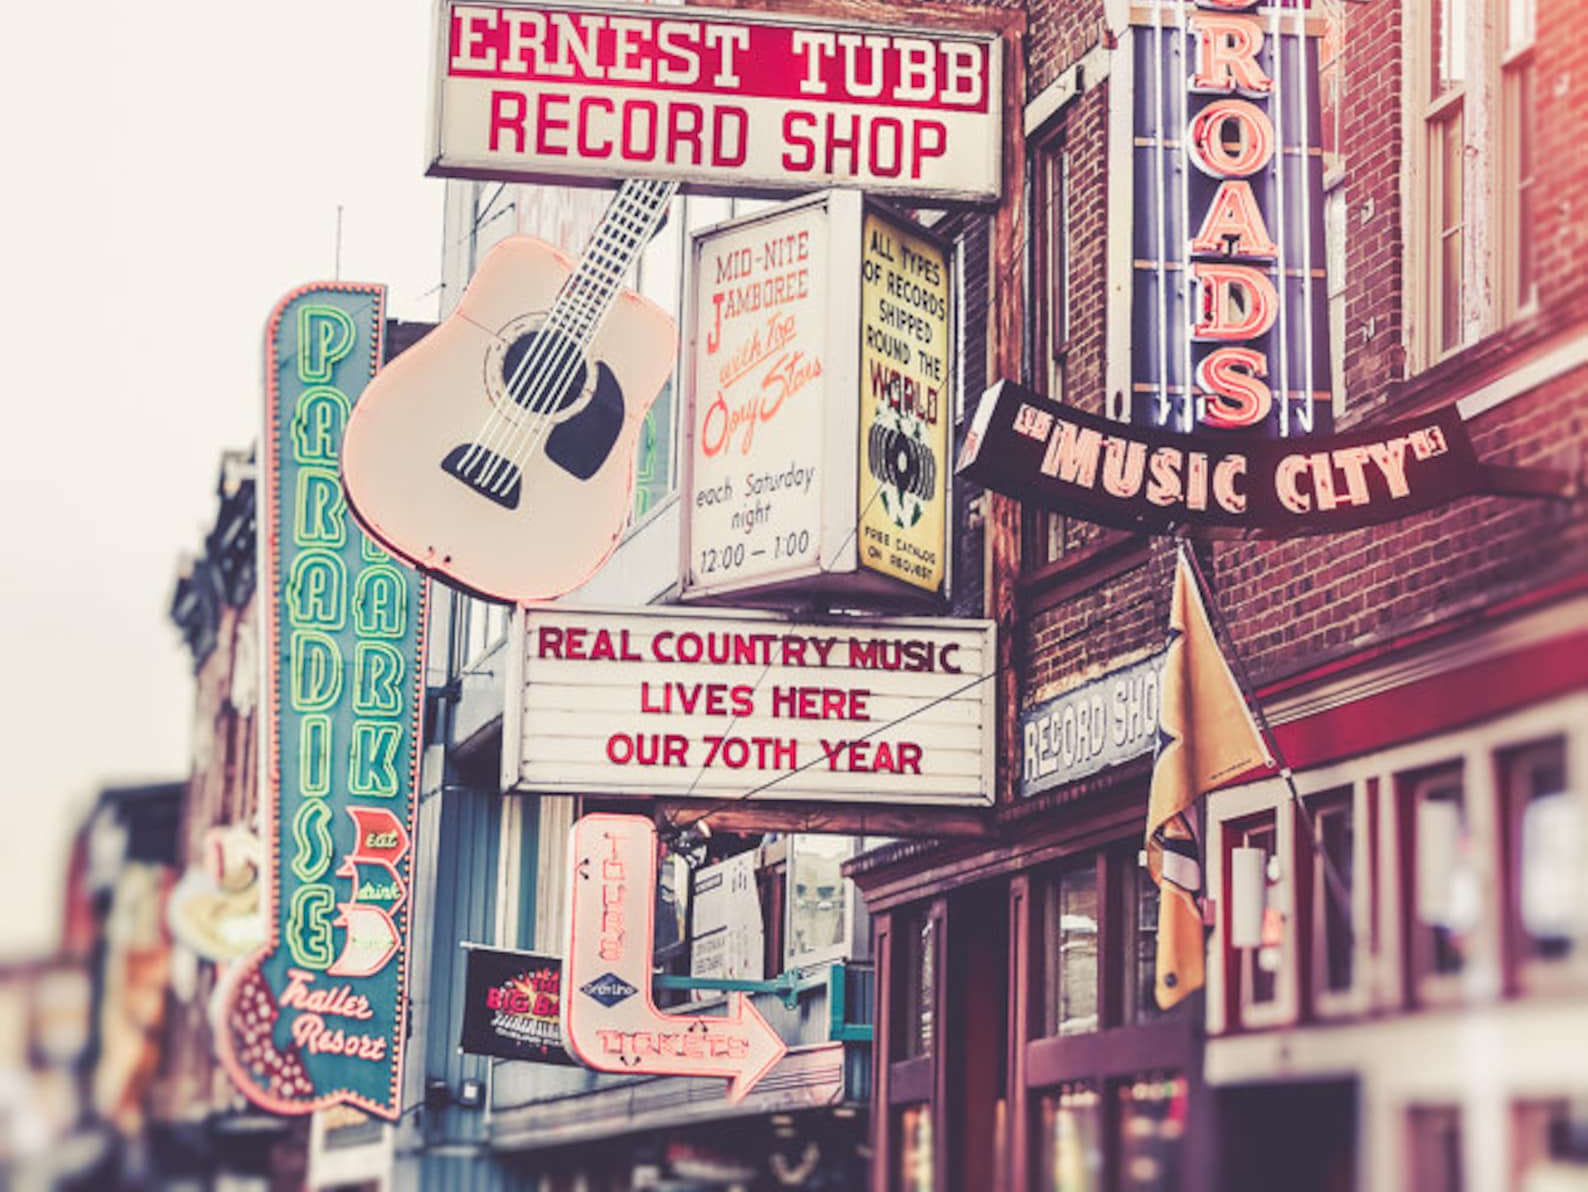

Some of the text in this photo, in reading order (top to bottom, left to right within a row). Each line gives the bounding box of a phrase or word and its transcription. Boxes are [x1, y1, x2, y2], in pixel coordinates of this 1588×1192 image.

[451, 6, 984, 106] ERNEST TUBB
[488, 90, 947, 179] RECORD SHOP
[716, 230, 809, 285] MID-NITE
[870, 229, 939, 287] ALL TYPES
[706, 269, 809, 356] JAMBOREE
[863, 259, 945, 323] OF RECORDS
[880, 298, 933, 344] SHIPPED
[719, 310, 795, 385] with Top
[866, 323, 941, 382] ROUND THE
[701, 351, 822, 457] Opry Stars
[870, 358, 938, 426] WORLD
[696, 460, 816, 508] each Saturday
[731, 498, 771, 535] night
[864, 525, 890, 547] FREE
[701, 543, 745, 574] 12:00
[867, 545, 883, 560] ON
[286, 304, 356, 970] PARADISE
[537, 626, 963, 675] REAL COUNTRY MUSIC
[348, 533, 408, 798] ARK
[641, 681, 871, 722] LIVES HERE
[1023, 668, 1161, 784] RECORD SHO
[606, 732, 924, 775] OUR 70TH YEAR
[365, 829, 400, 849] eat
[279, 968, 374, 1020] Trailer
[486, 987, 530, 1015] BIG
[291, 1012, 387, 1061] Resort
[596, 1029, 750, 1059] TICKETS
